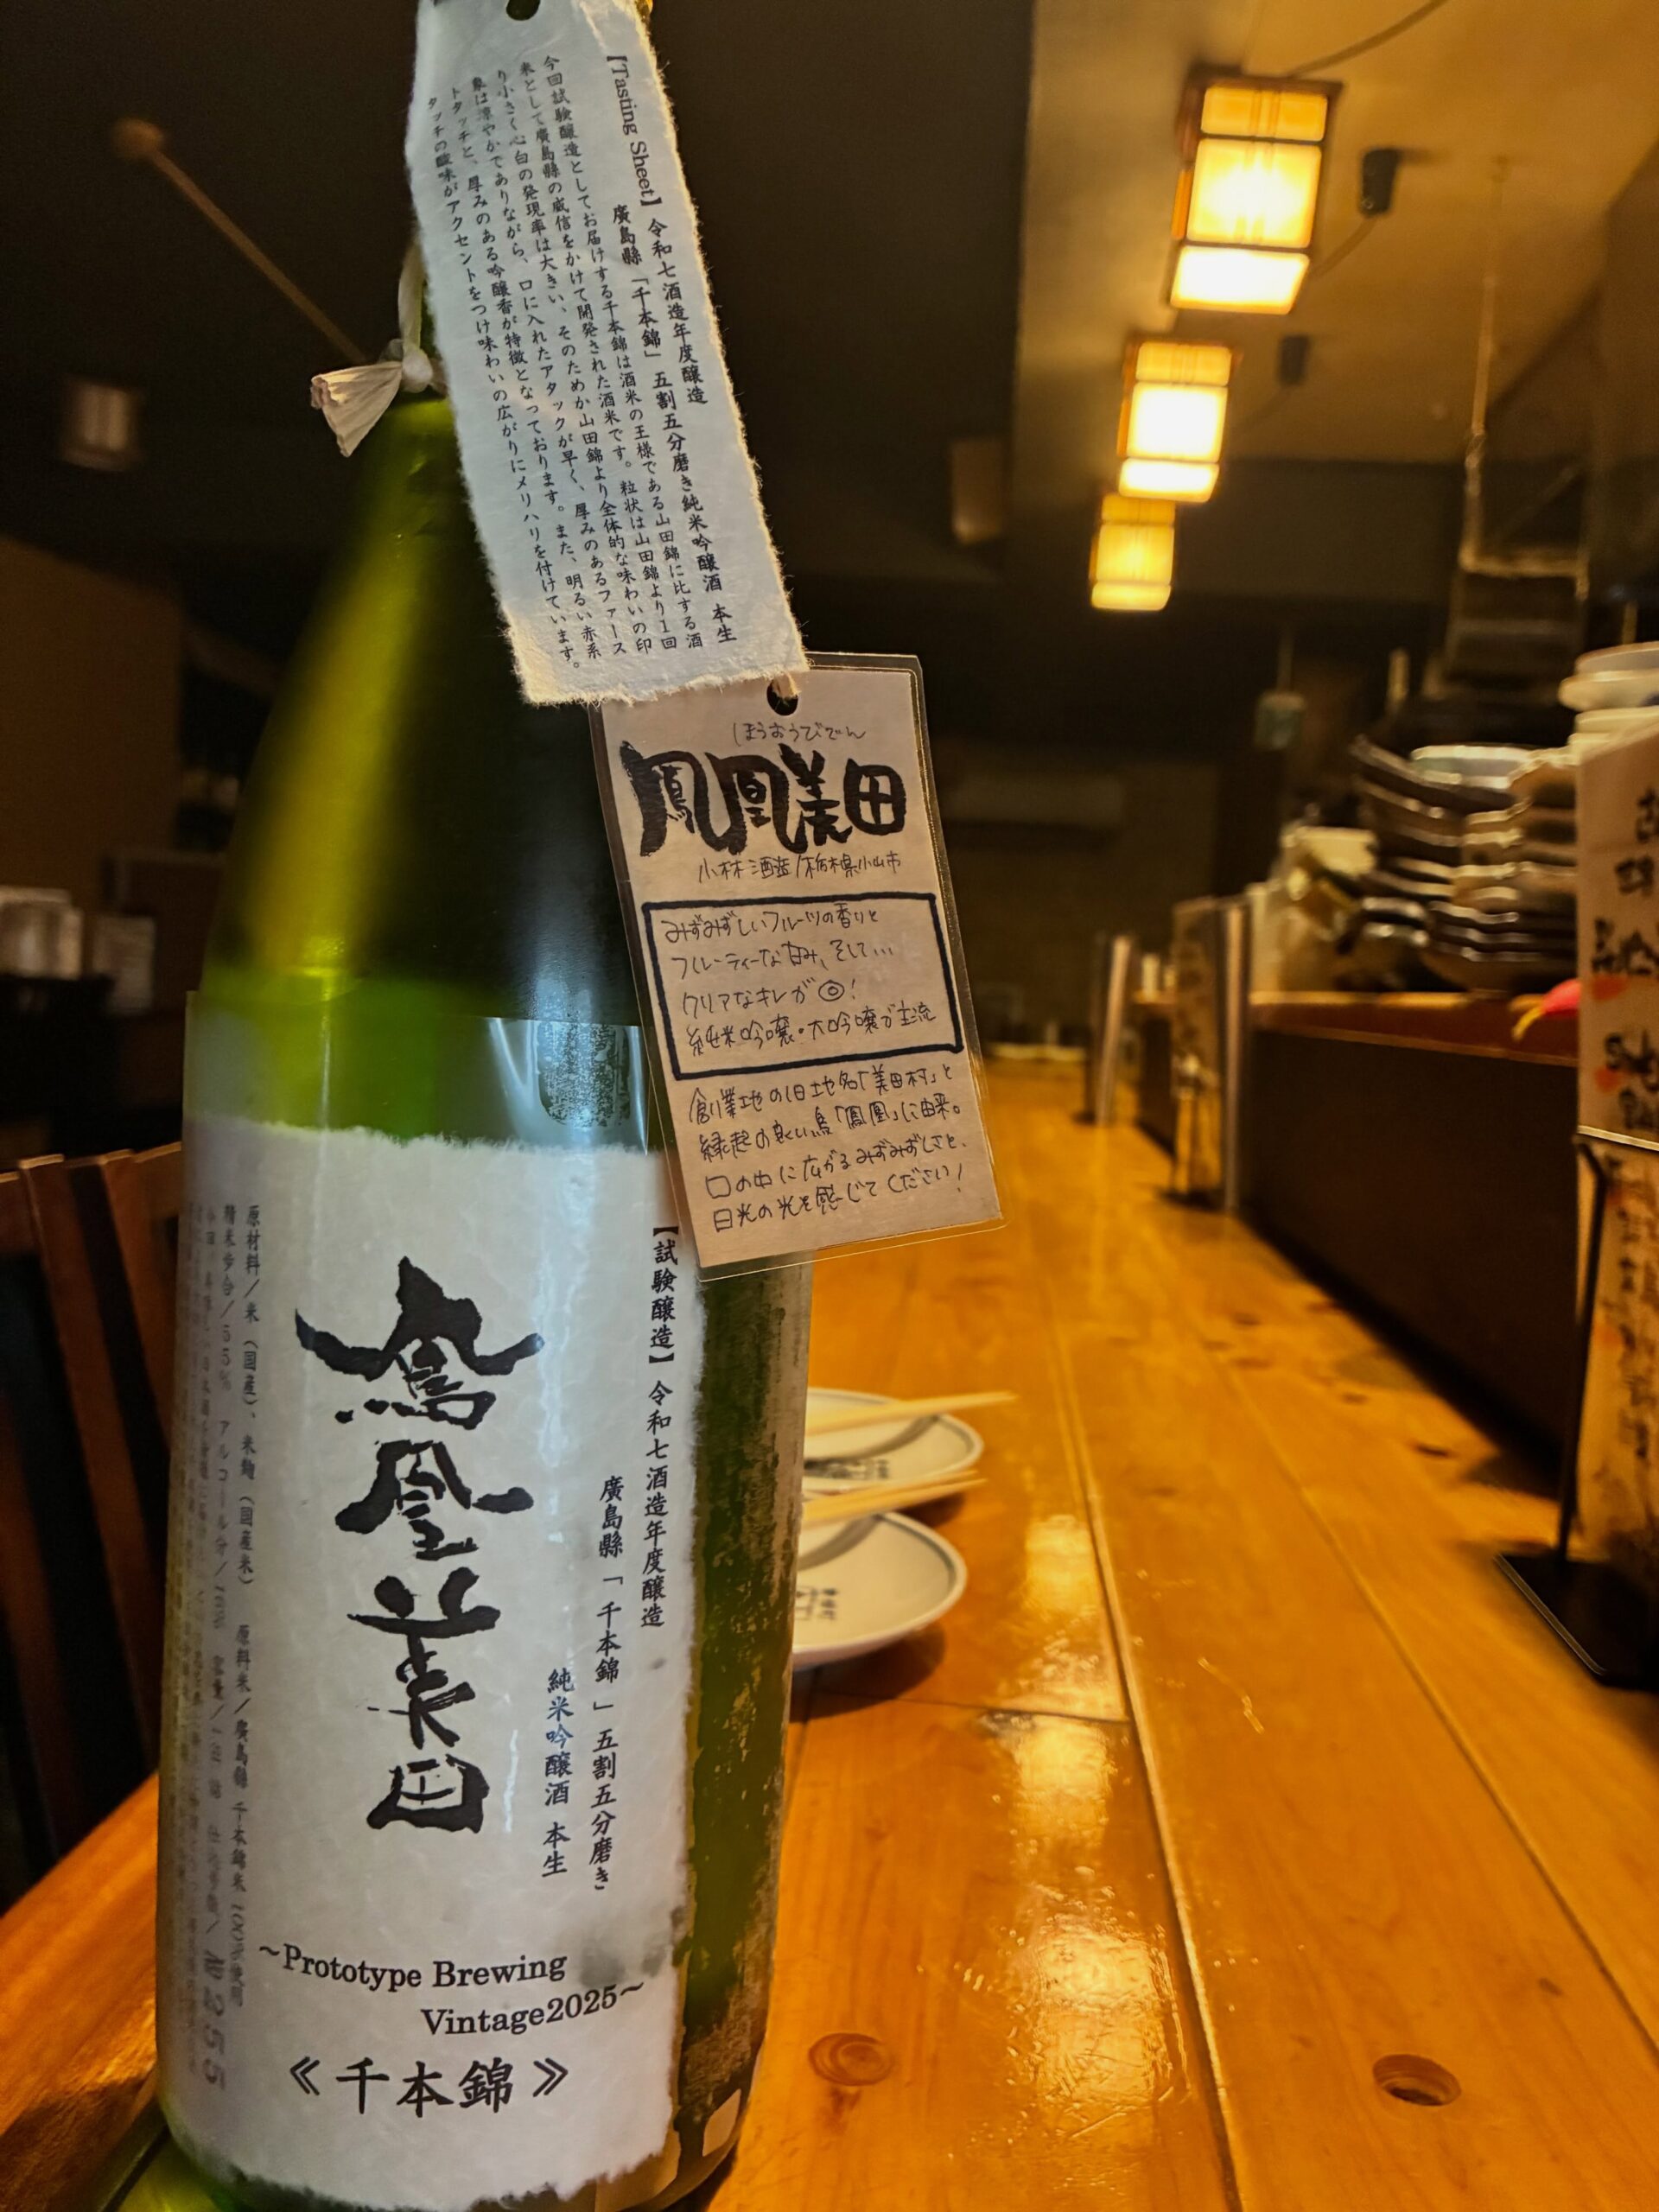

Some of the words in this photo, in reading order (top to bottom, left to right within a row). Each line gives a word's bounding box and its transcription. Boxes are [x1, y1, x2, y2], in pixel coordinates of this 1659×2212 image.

[712, 603, 737, 644] 本生
[733, 721, 867, 747] ほうおうびでん
[620, 741, 907, 857] 鳳凰美田
[542, 1821, 571, 1878] 本生
[432, 1955, 568, 1987] Brewing
